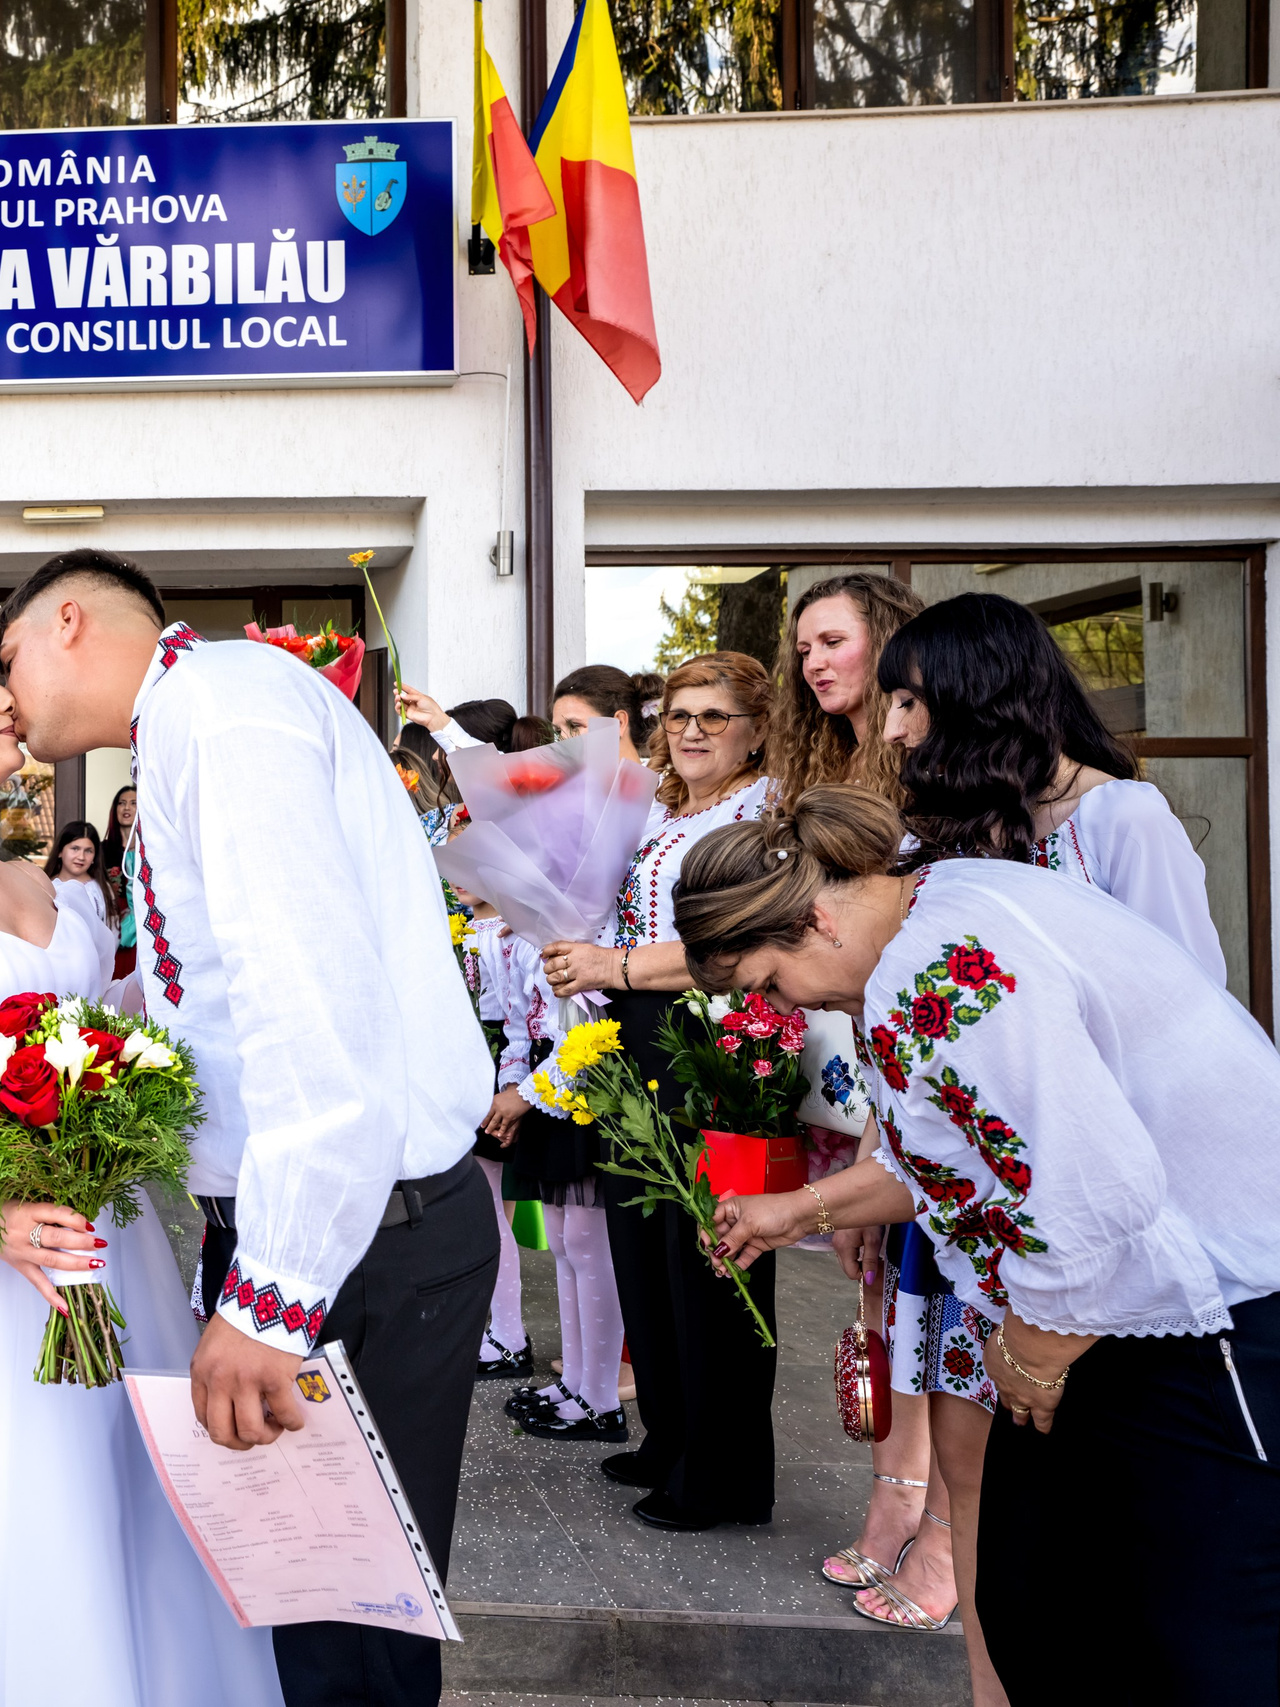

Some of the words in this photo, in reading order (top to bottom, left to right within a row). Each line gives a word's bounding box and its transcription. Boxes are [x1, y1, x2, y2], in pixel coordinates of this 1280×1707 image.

[55, 193, 228, 227] PRAHOVA
[46, 228, 346, 309] VĂRBILĂU
[5, 318, 211, 354] CONSILIUL
[222, 314, 348, 349] LOCAL
